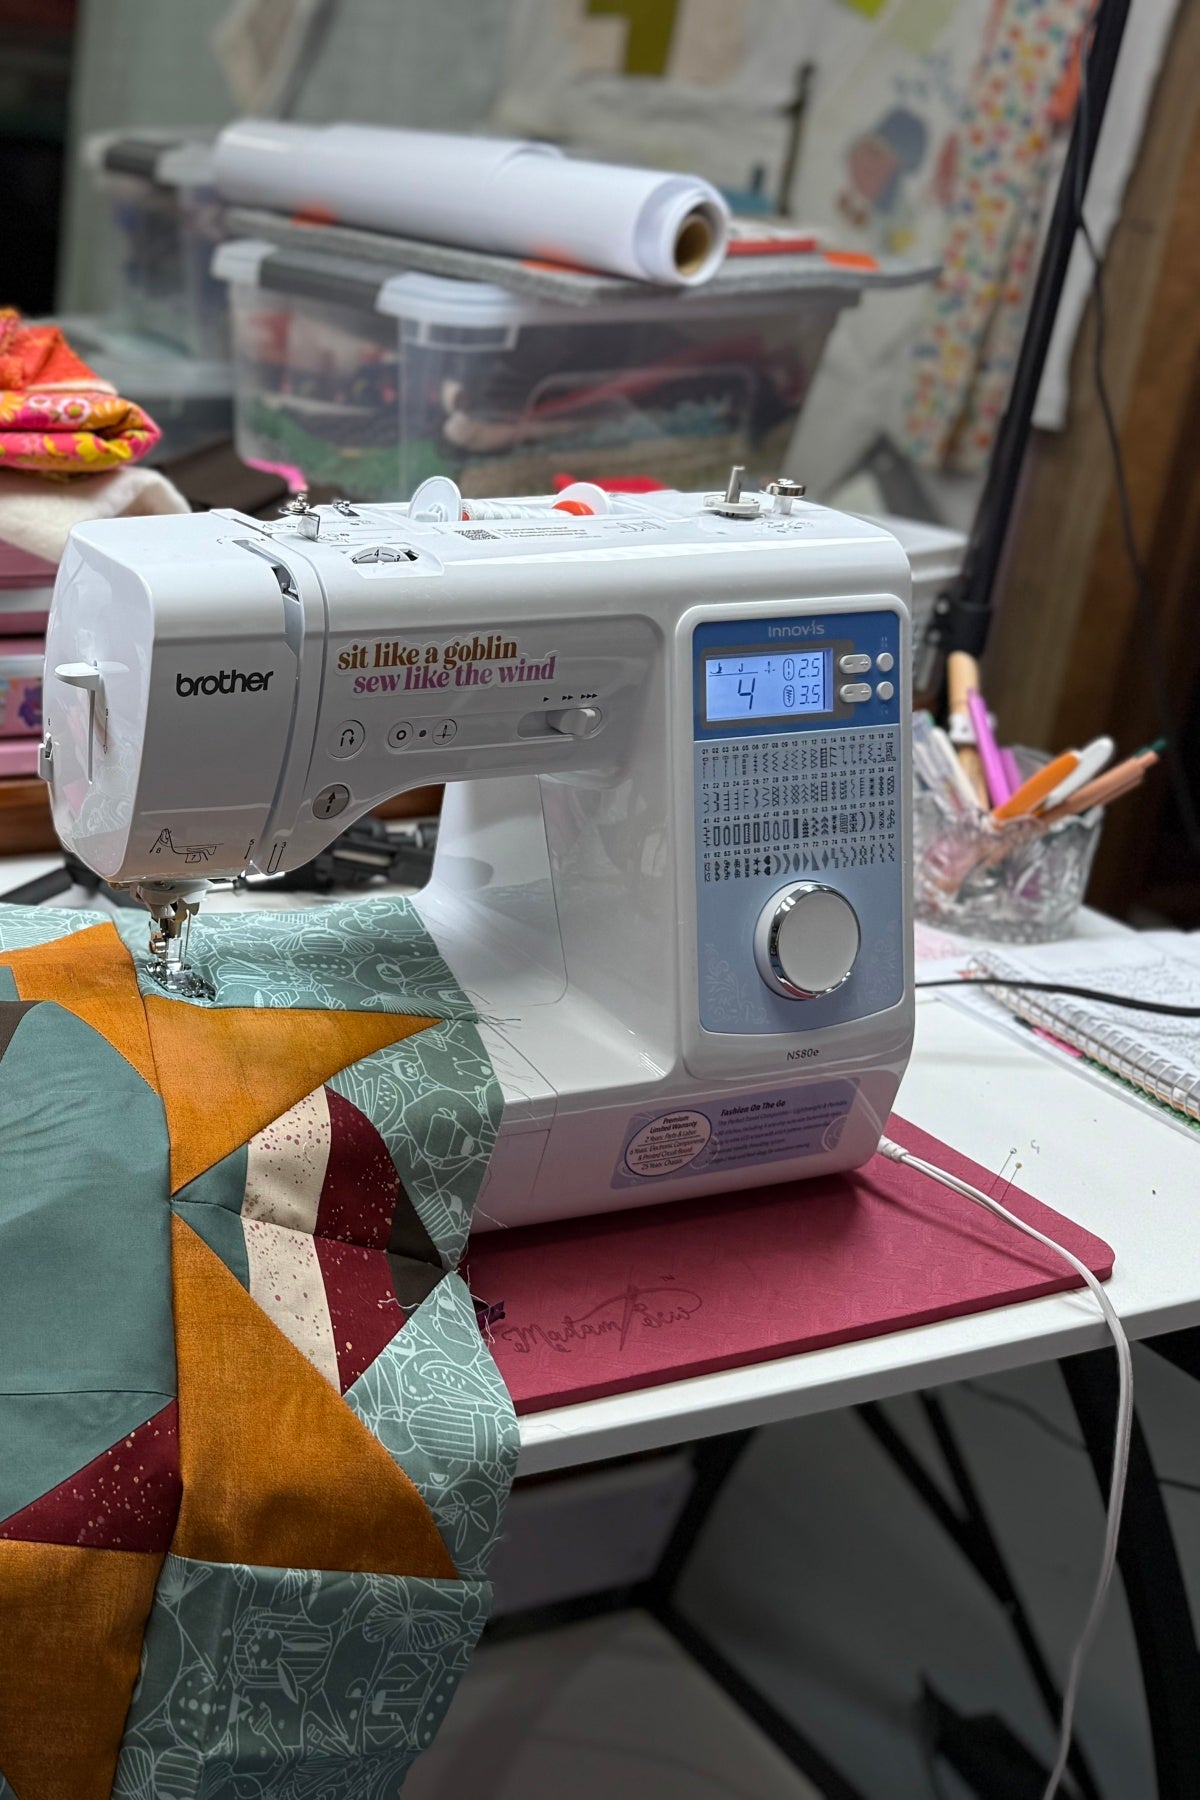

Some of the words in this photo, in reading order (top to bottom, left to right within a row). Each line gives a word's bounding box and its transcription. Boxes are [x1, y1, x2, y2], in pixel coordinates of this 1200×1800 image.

[337, 644, 369, 670] sit
[374, 642, 419, 667] like
[424, 648, 438, 664] a
[443, 635, 518, 670] goblin
[353, 672, 402, 694] sew
[404, 665, 450, 690] like
[454, 663, 493, 687] the
[500, 656, 556, 683] wind
[798, 658, 820, 678] 2.5
[176, 669, 274, 697] brother
[738, 677, 756, 710] 4
[800, 684, 820, 704] 3.5
[663, 1116, 689, 1124] Premium
[720, 1106, 749, 1116] Fashion
[650, 1125, 671, 1134] Limited
[672, 1121, 697, 1130] Warranty
